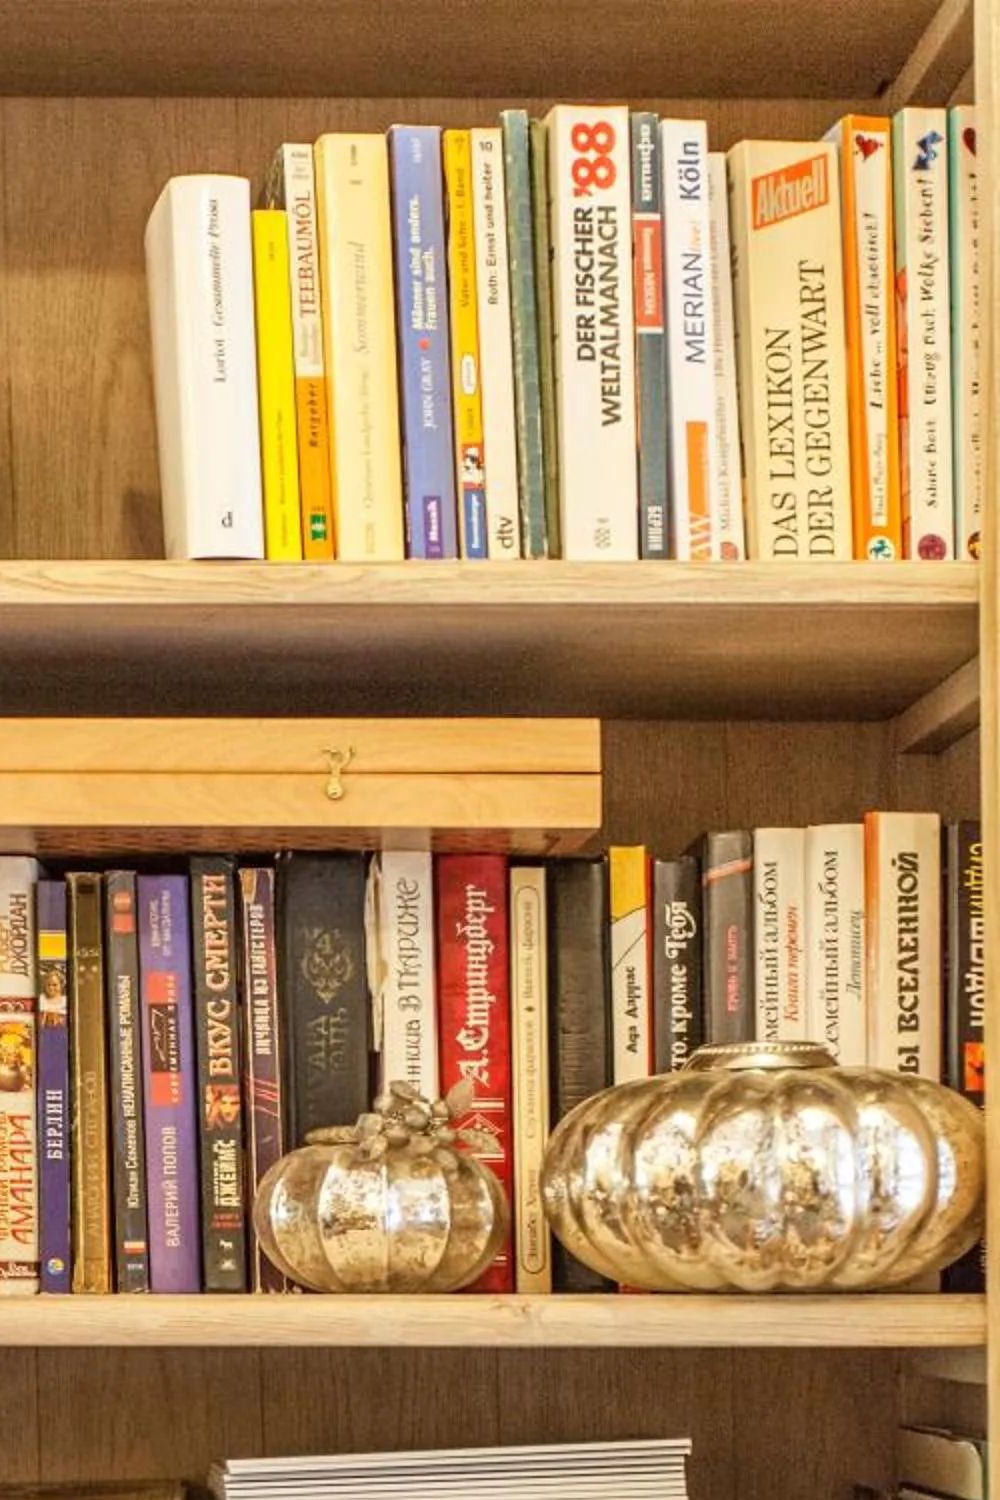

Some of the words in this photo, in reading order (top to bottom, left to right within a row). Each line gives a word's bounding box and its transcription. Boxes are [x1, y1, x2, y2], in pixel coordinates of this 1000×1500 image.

[677, 141, 702, 201] Köln
[756, 159, 827, 226] Aktuell
[481, 203, 496, 229] und
[292, 190, 319, 317] TEEBAUMÖL
[408, 248, 421, 277] sind
[574, 207, 596, 308] FISCHER
[409, 280, 425, 331] Männer
[422, 286, 439, 331] Frauen
[577, 313, 598, 362] DER
[596, 206, 623, 427] WELTALMANACH
[680, 253, 707, 365] MERIAN
[797, 259, 833, 476] GEGENWART
[764, 328, 797, 481] LEXIKON
[494, 515, 516, 550] dtv
[770, 492, 800, 557] DAS
[807, 486, 836, 556] DER
[757, 861, 779, 943] альбом
[817, 851, 839, 933] альбом
[9, 894, 30, 976] ДЖОРДАН
[201, 874, 230, 992] СМЕРТИ
[664, 900, 697, 960] Тебя
[845, 887, 867, 1001] Летописец
[891, 852, 920, 1034] ВСЕЛЕННОЙ
[117, 976, 132, 1025] РОМАНЫ
[670, 963, 693, 1034] кроме
[782, 969, 801, 1023] Книга
[117, 1028, 137, 1118] НЕНАПИСАННЫЕ
[206, 998, 234, 1078] ВКУС
[45, 1088, 64, 1161] БЕРЛИН
[161, 1126, 178, 1175] ПОПОВ
[8, 1114, 34, 1245] АМАНАРА
[161, 1178, 181, 1247] ВАЛЕРИЙ
